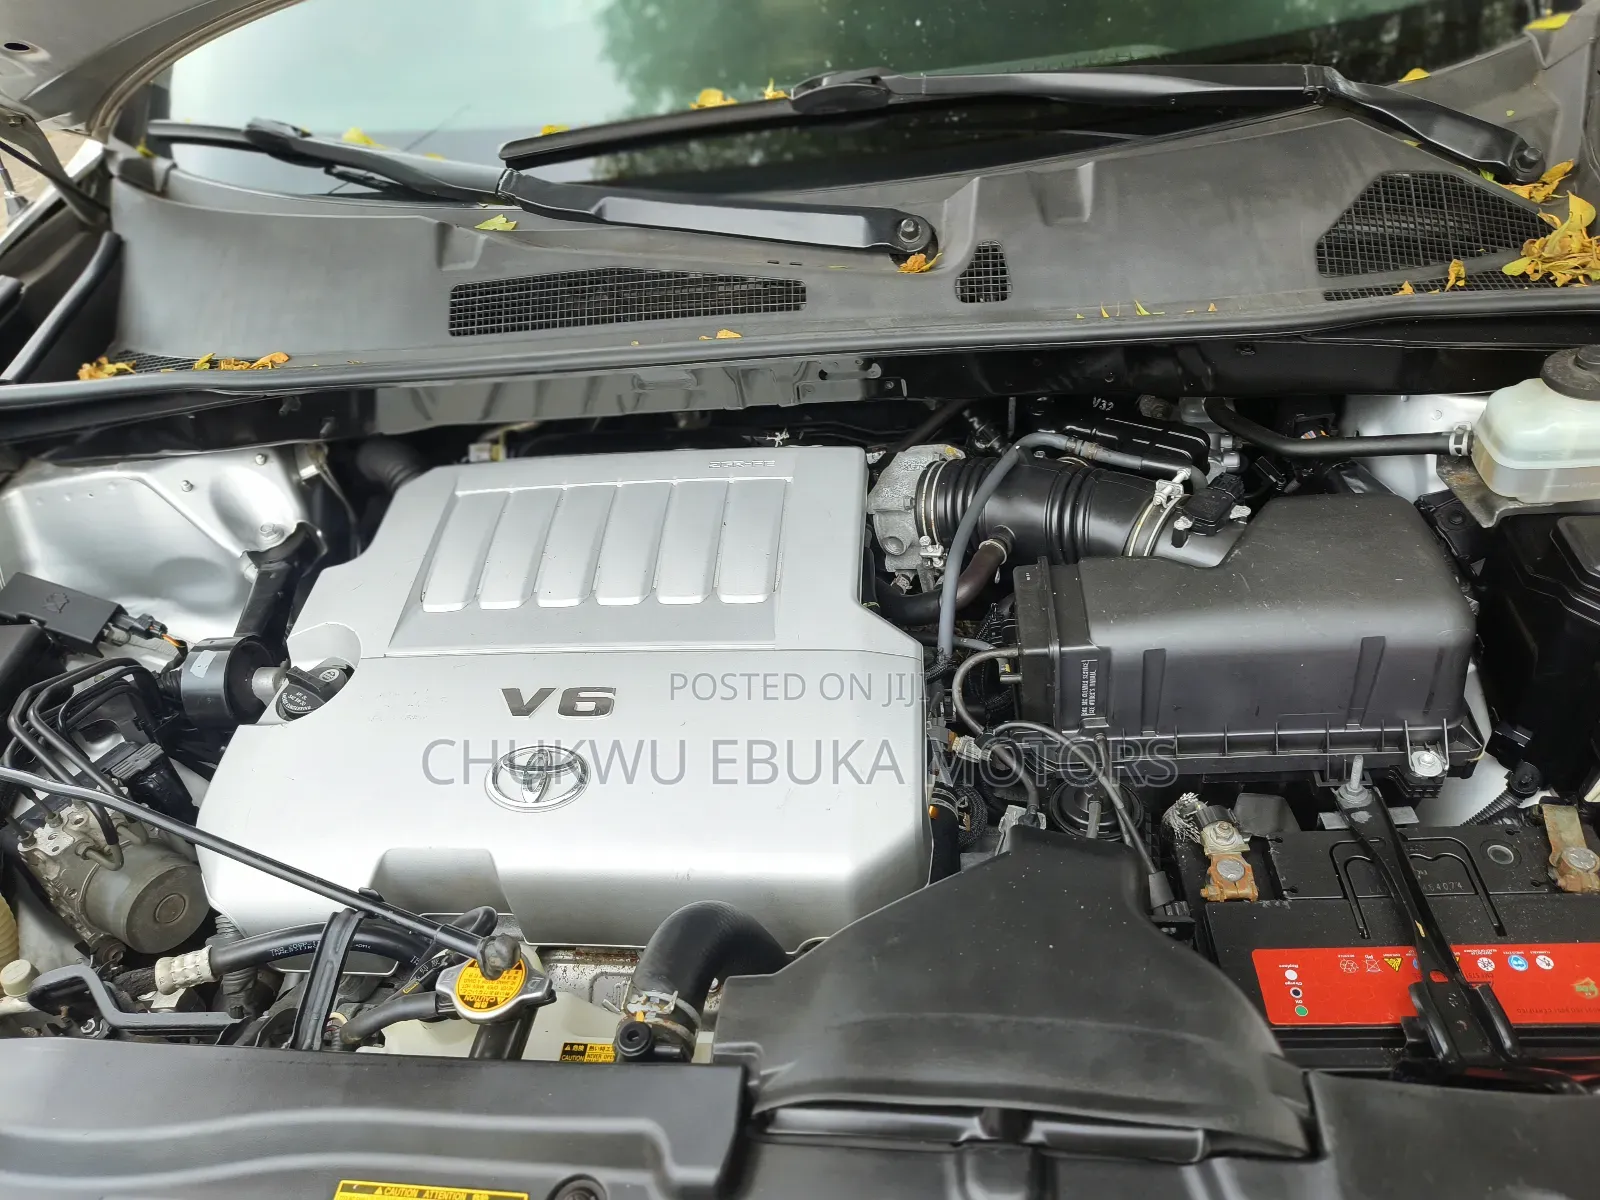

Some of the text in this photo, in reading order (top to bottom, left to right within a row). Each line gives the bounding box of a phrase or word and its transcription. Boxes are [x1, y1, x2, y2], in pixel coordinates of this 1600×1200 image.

[500, 686, 618, 721] V6
[463, 994, 496, 1002] CAUTION
[561, 1054, 585, 1062] CAUTION
[384, 1186, 418, 1198] CAUTION
[422, 1190, 467, 1200] ATTENTION
